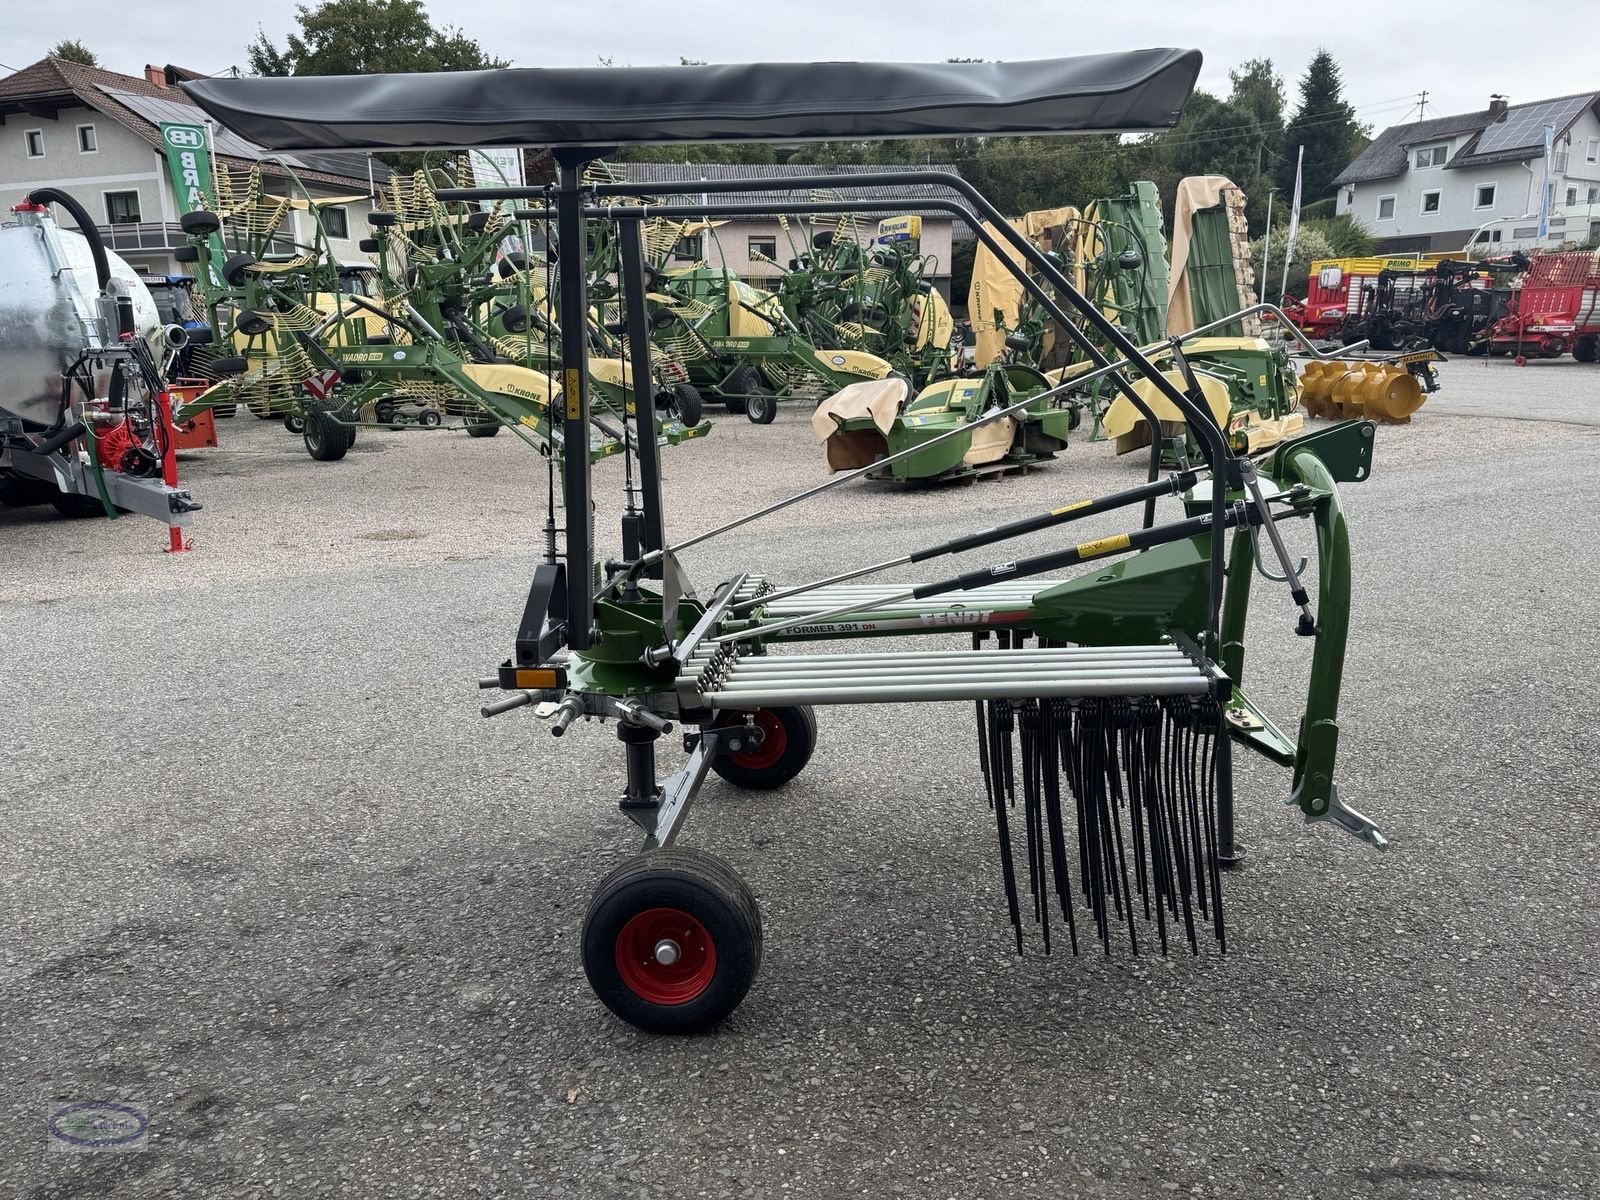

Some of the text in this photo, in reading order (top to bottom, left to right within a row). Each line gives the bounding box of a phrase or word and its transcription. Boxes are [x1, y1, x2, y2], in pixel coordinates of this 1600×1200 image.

[342, 353, 368, 361] WADRO
[1402, 353, 1434, 362] MAMMUT
[858, 369, 880, 378] KRONE
[515, 388, 542, 400] KRONE
[919, 610, 994, 625] FENDT
[786, 624, 836, 634] FORMER
[838, 623, 859, 631] 391
